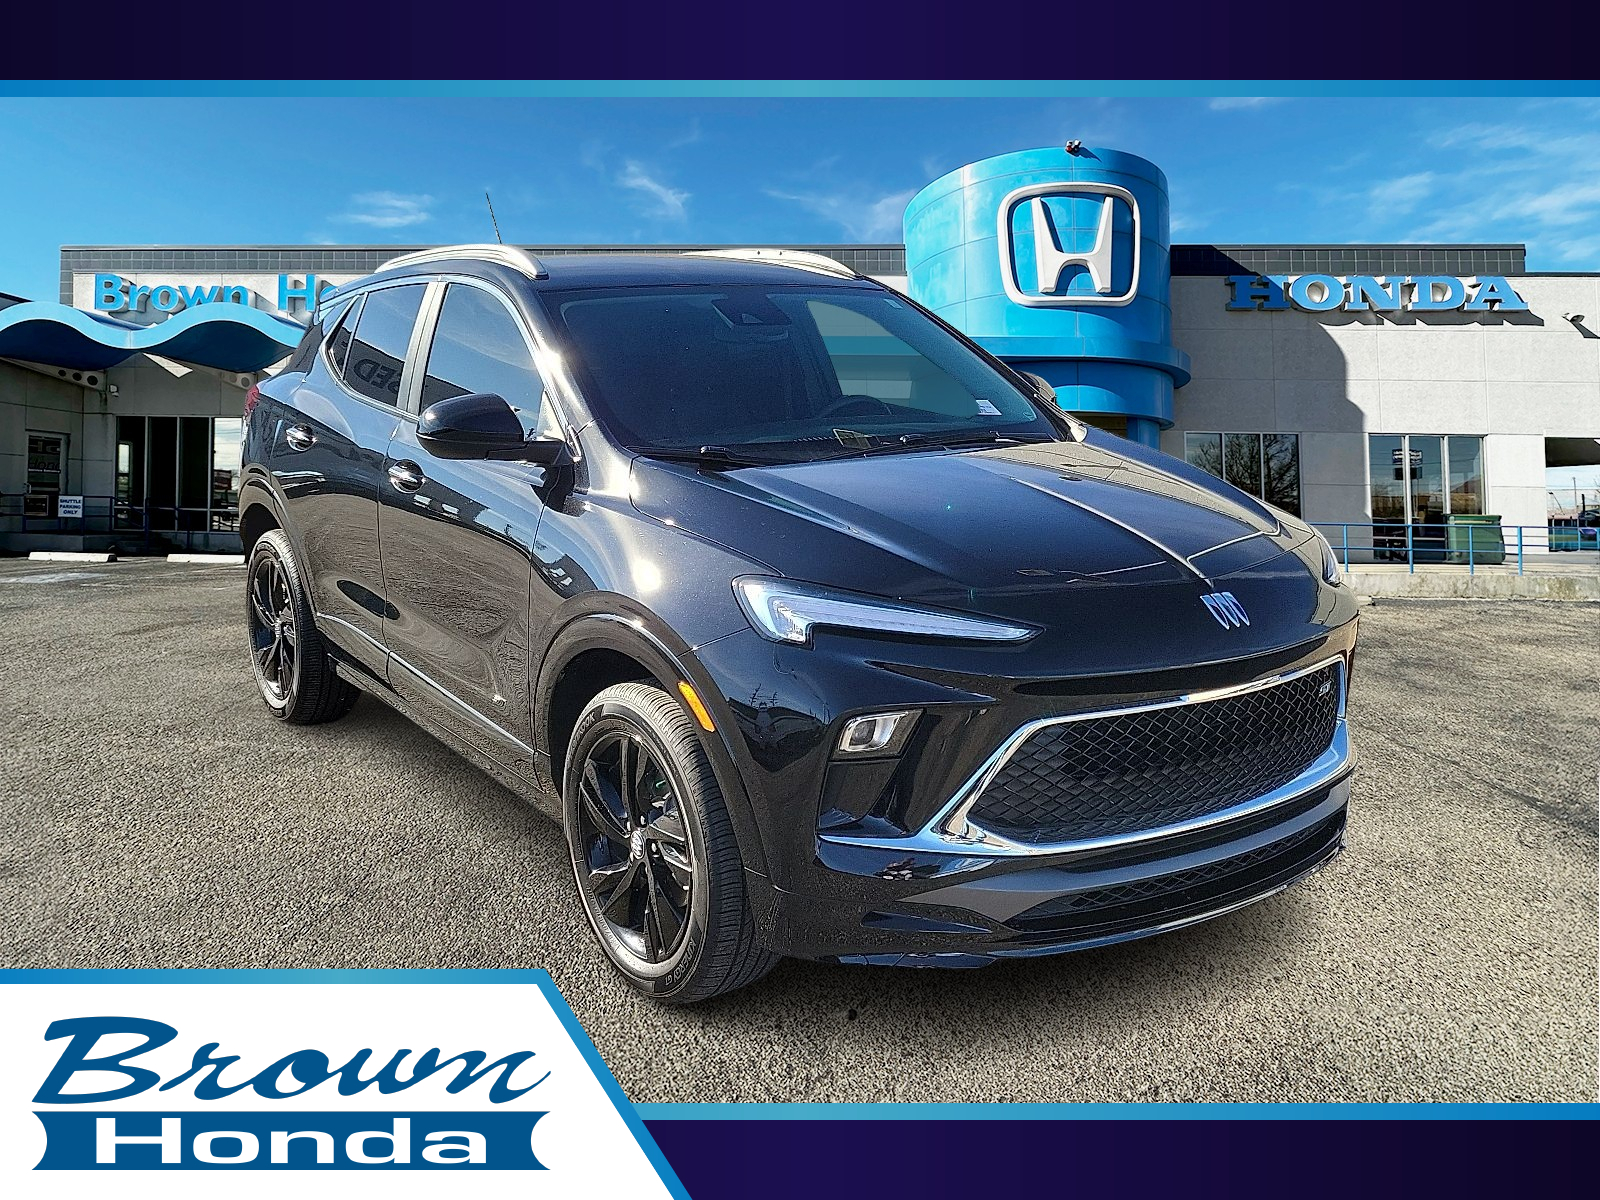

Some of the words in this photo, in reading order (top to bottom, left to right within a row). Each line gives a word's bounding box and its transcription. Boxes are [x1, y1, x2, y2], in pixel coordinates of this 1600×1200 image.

[95, 272, 249, 311] Brown
[278, 273, 338, 311] H
[1228, 273, 1528, 312] HONDA
